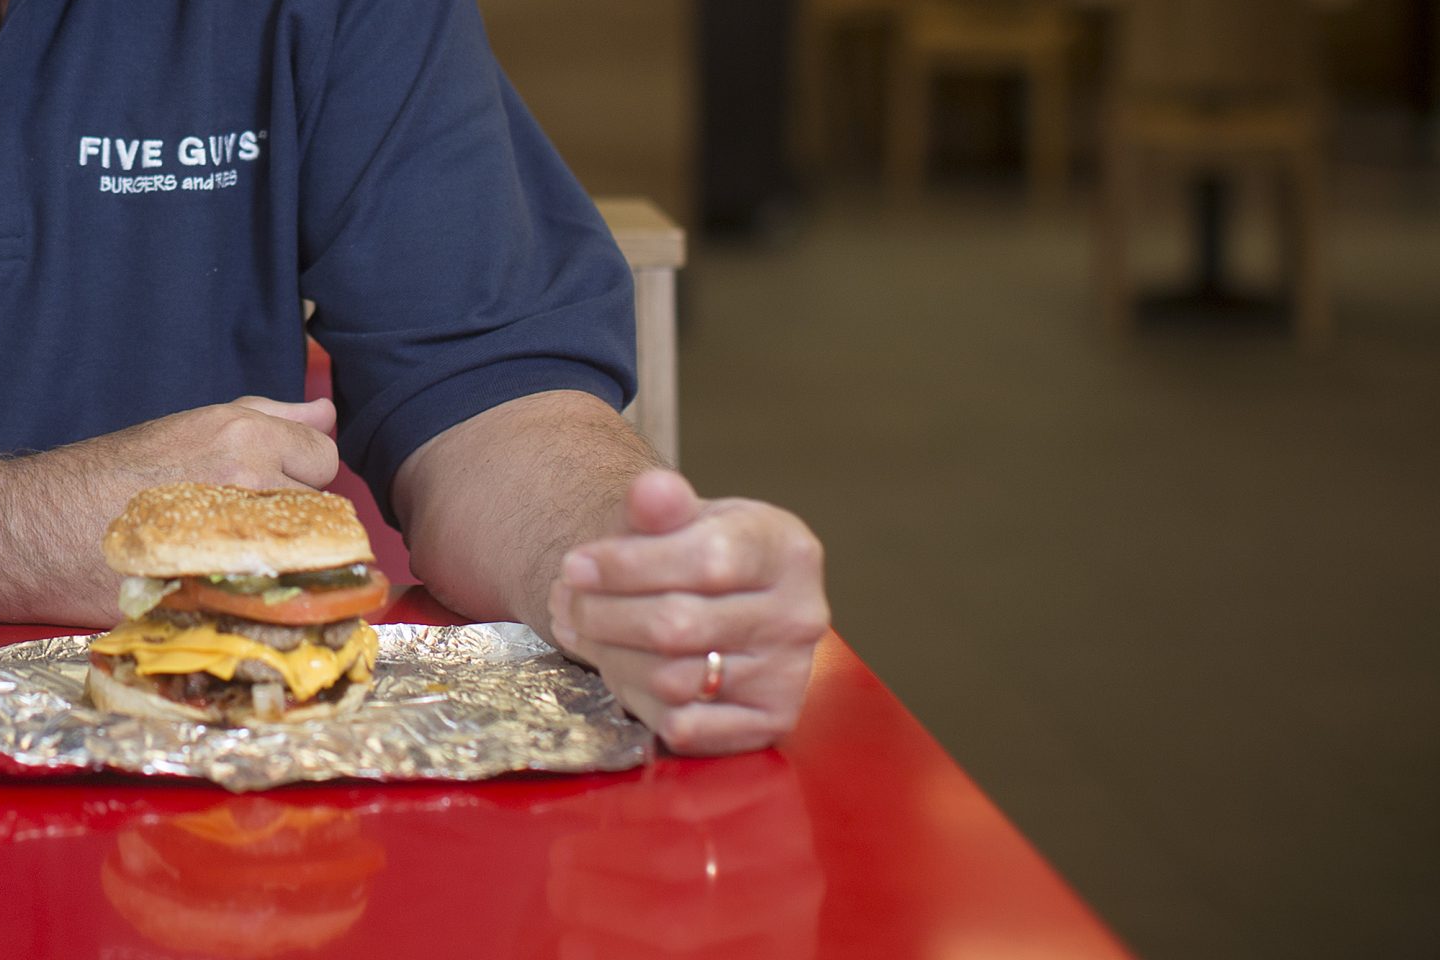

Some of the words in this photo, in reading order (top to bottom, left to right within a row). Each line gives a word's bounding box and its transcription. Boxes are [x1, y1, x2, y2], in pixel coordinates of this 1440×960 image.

[78, 136, 164, 171] FIVE
[177, 130, 260, 167] GUYS
[99, 173, 178, 194] BURGERS
[181, 172, 214, 191] and
